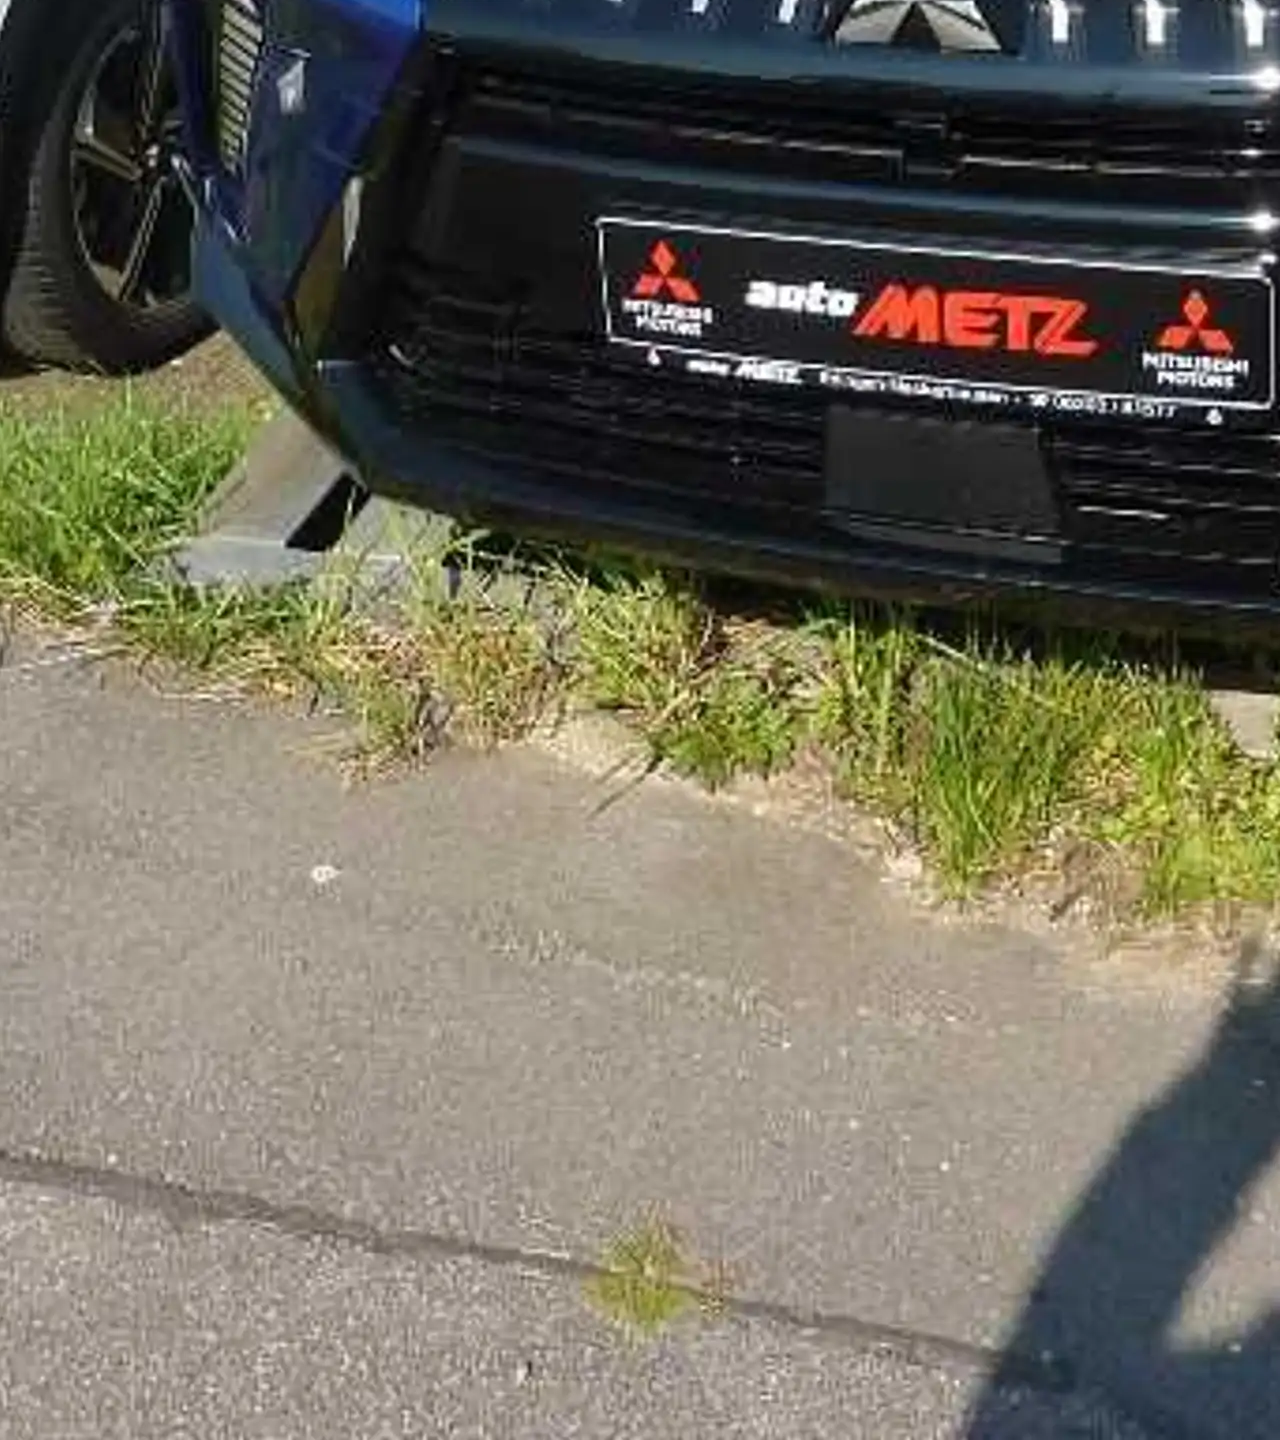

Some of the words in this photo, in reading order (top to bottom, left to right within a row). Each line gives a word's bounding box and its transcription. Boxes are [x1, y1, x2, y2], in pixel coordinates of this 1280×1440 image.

[744, 280, 860, 317] auto
[852, 284, 1099, 356] METZ
[1141, 351, 1251, 377] MITSUBISHI
[1156, 370, 1236, 389] MOTORS
